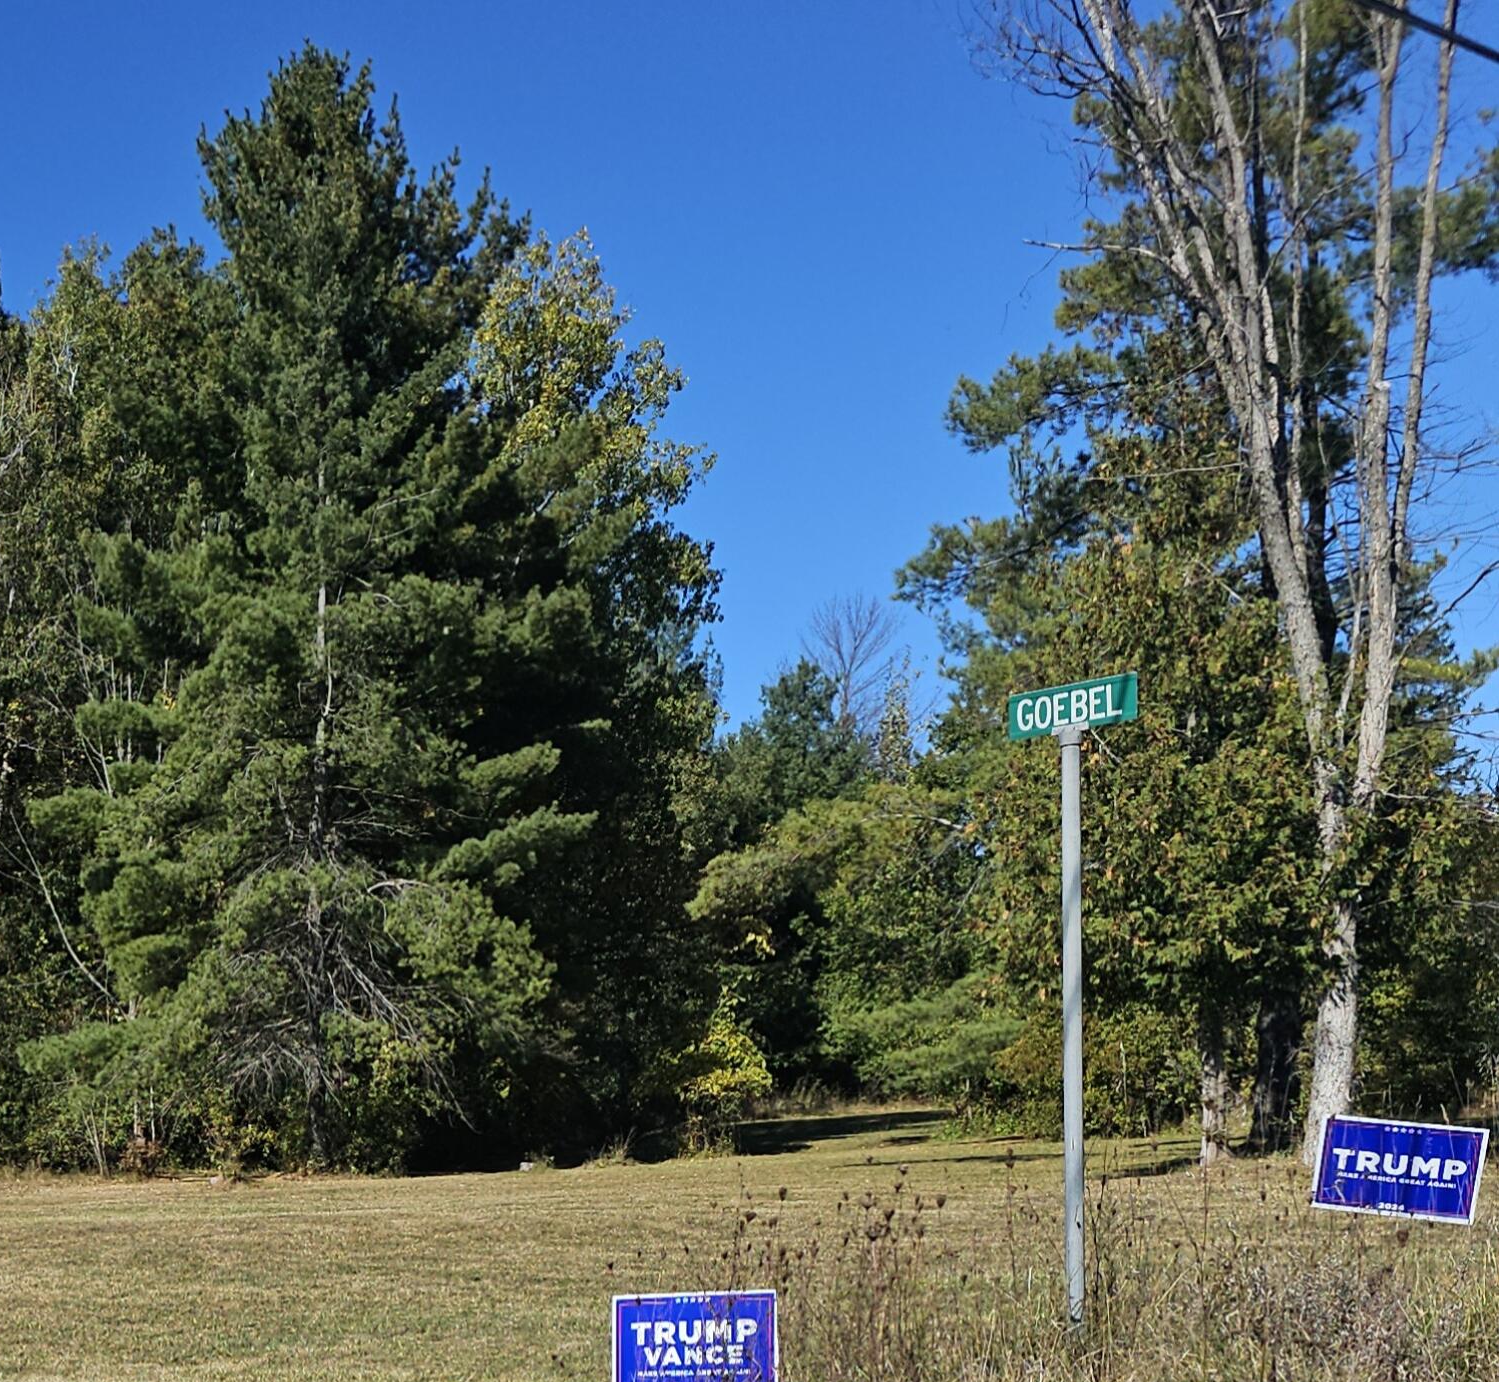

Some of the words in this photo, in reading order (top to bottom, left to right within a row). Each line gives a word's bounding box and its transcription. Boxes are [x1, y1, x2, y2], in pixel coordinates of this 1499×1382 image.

[1016, 684, 1123, 731] GOEBEL
[1332, 1147, 1467, 1181] TRUMP
[1427, 1181, 1457, 1189] AGAIN!
[1377, 1202, 1405, 1211] 2024
[631, 1318, 758, 1346] TRUMP
[643, 1344, 744, 1367] VANCE
